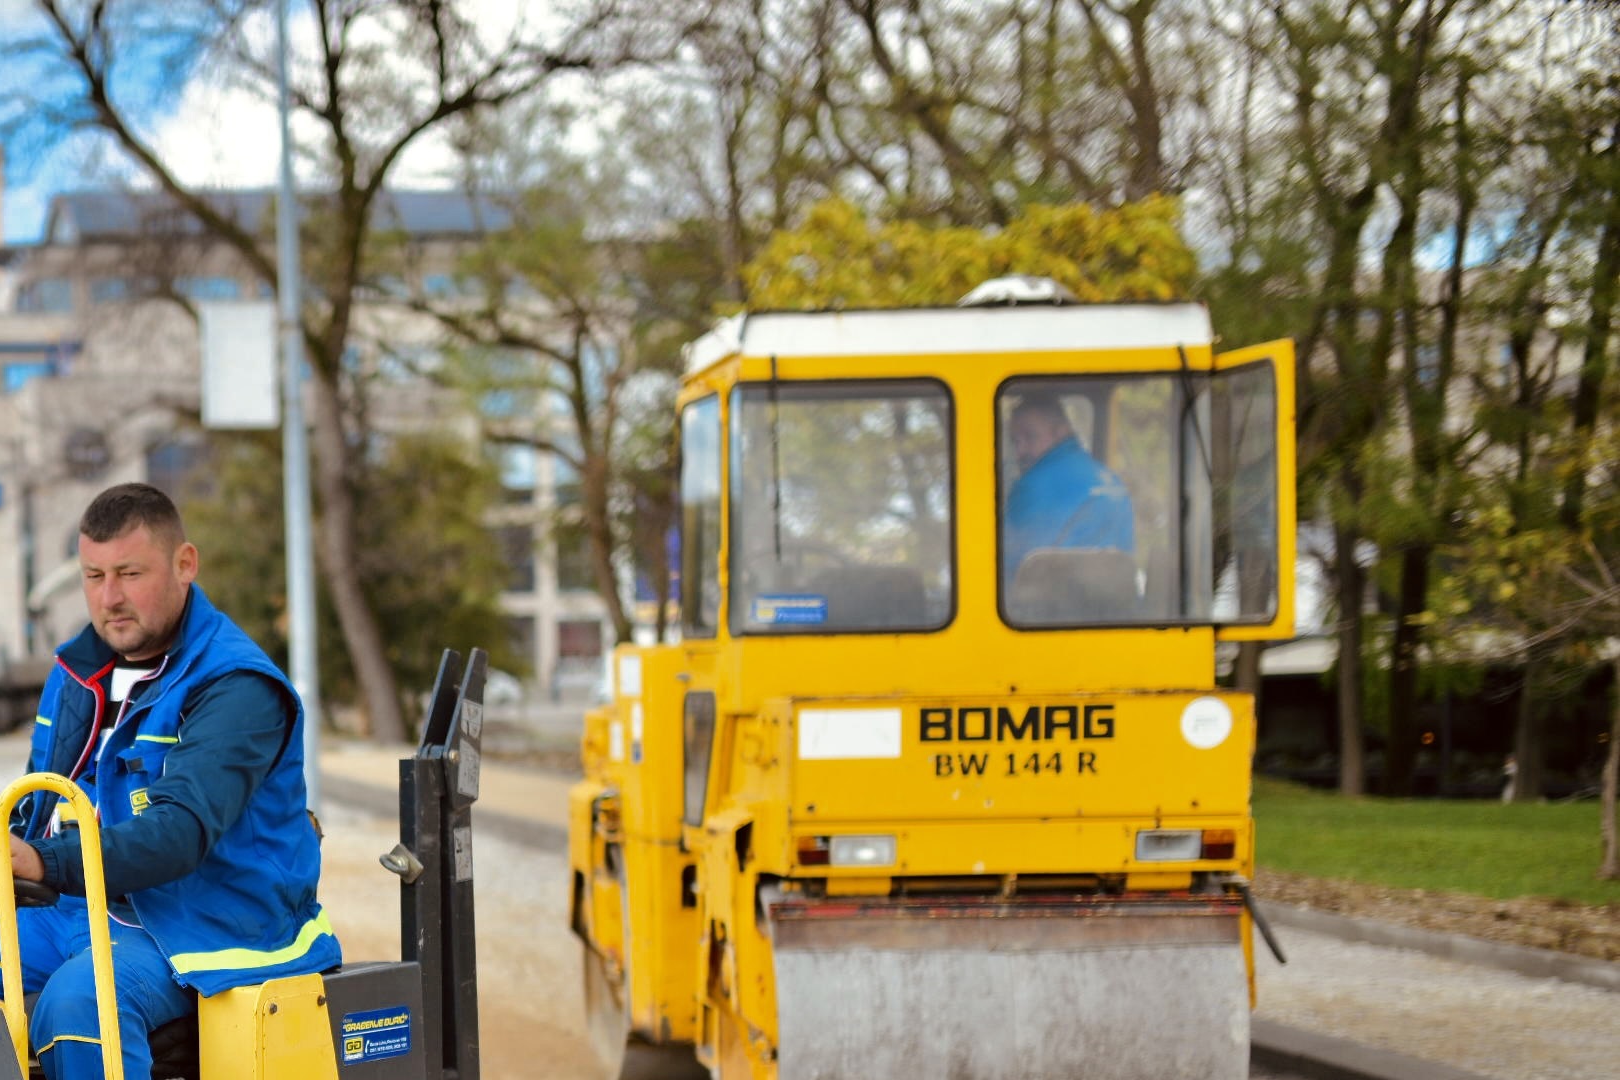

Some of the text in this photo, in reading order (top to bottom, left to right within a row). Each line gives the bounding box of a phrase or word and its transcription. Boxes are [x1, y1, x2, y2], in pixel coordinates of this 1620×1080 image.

[919, 704, 1115, 742] BOMAG
[935, 751, 1098, 777] BW 144 R
